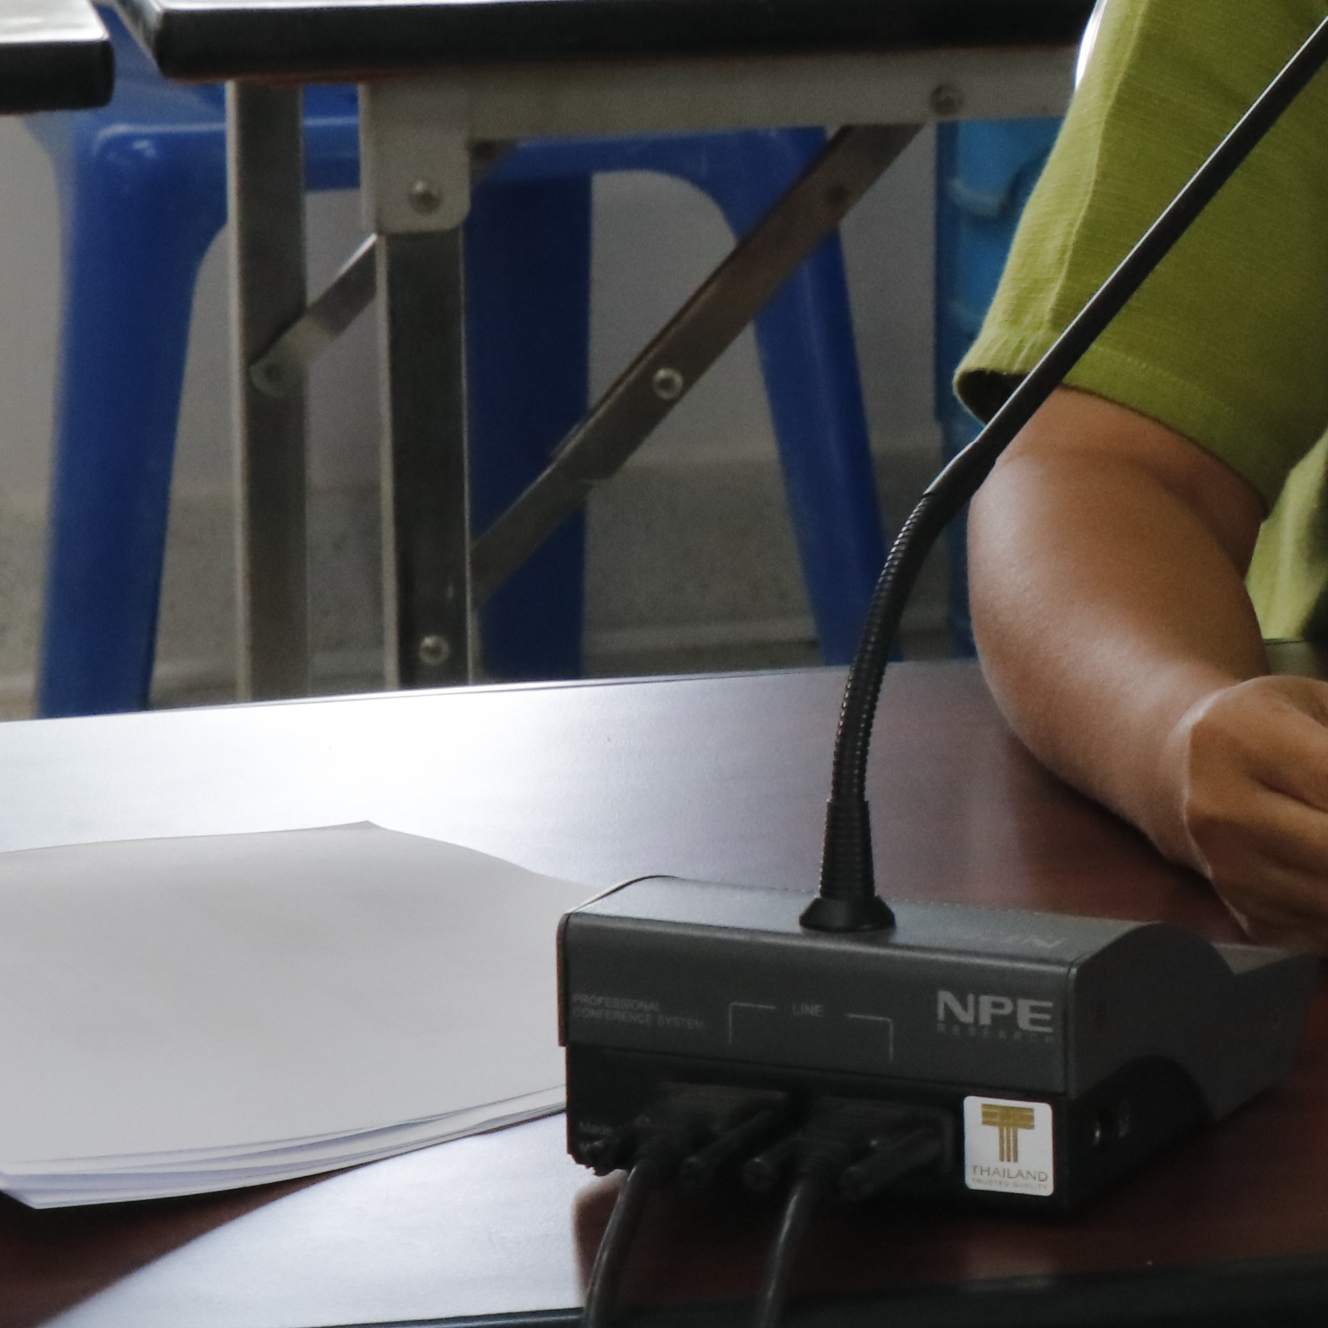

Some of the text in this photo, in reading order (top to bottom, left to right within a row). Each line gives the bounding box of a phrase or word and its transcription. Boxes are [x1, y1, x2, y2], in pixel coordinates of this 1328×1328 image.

[572, 993, 660, 1012] PROFESSIONAL
[792, 1003, 824, 1017] LINE
[937, 990, 1054, 1033] NPE
[573, 1007, 706, 1030] CONFERENCE SYSTEM
[937, 1023, 1054, 1043] RESEARCH
[971, 1165, 1048, 1182] THAILAND
